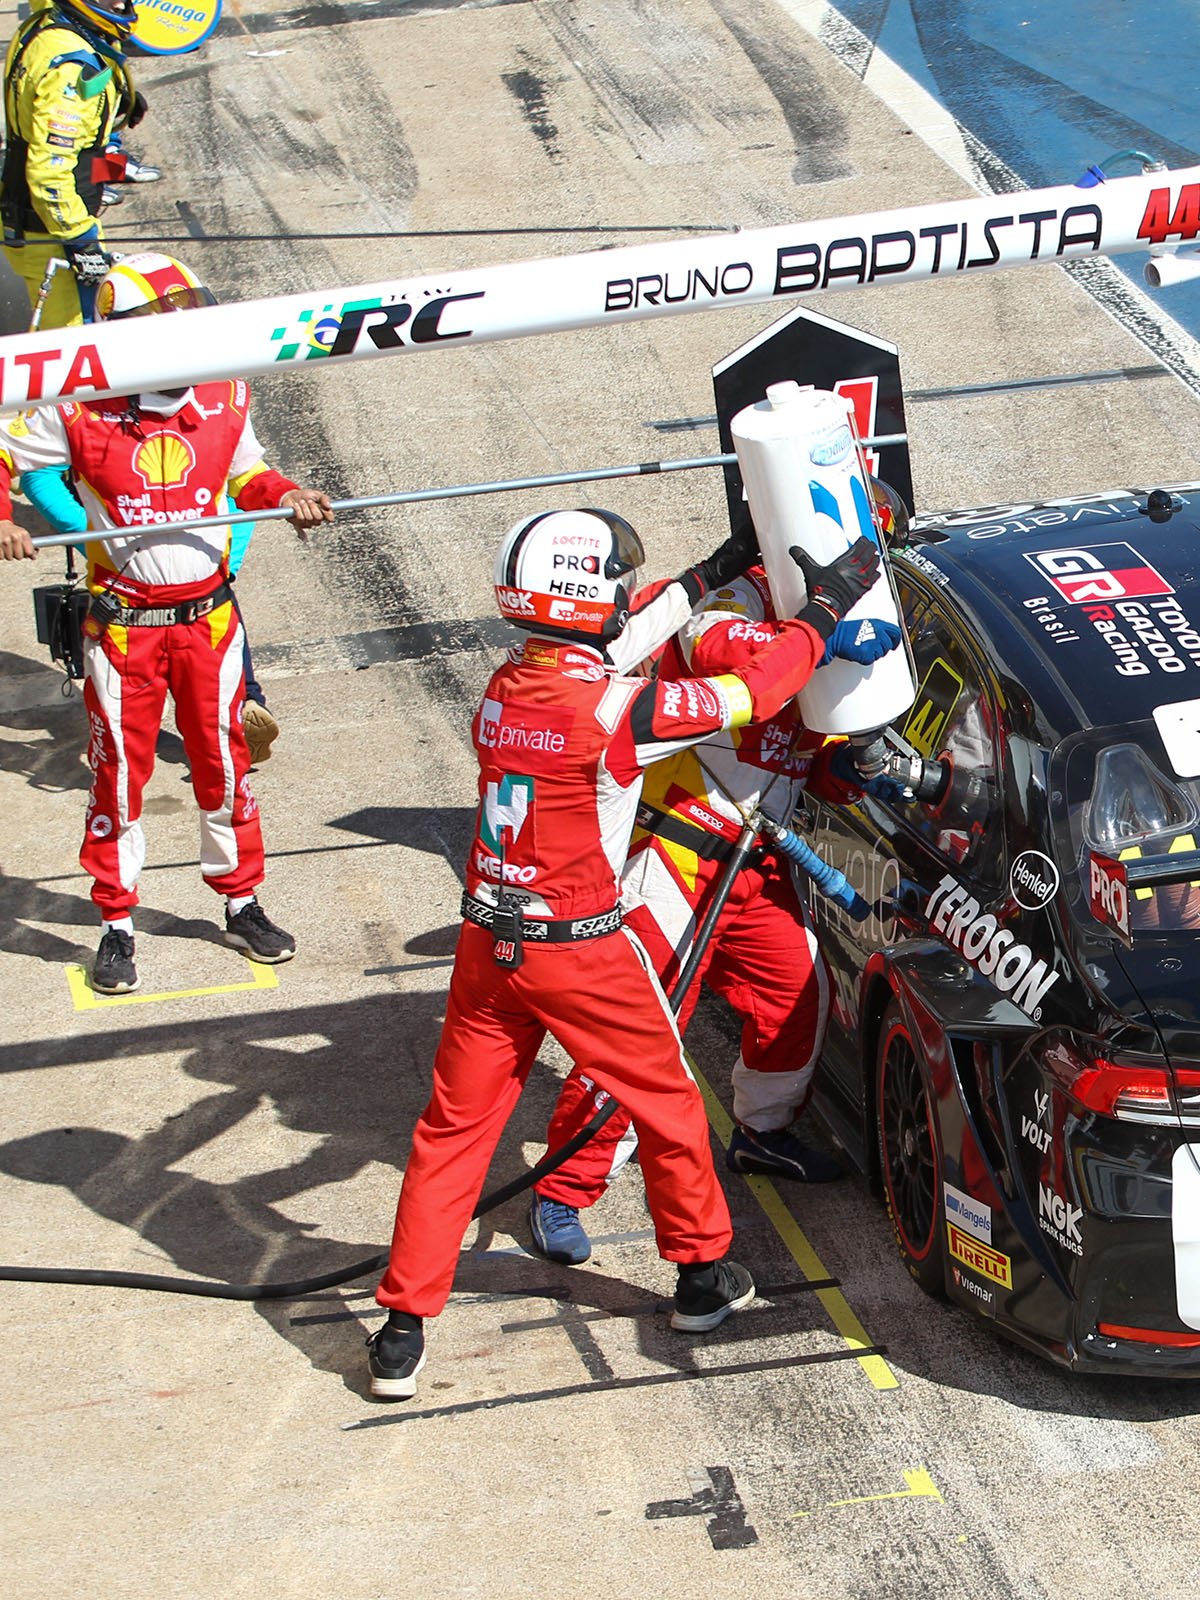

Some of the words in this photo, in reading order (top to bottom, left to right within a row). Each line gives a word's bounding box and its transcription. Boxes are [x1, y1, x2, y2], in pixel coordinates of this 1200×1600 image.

[604, 262, 754, 312] BRUNO
[773, 203, 1103, 296] BAPTISTA
[327, 290, 486, 357] RC
[0, 343, 111, 402] TA
[117, 493, 151, 508] Shell
[118, 507, 205, 526] V-Power
[552, 536, 600, 549] LOCTITE
[553, 553, 600, 575] PRO
[1037, 550, 1126, 601] GR
[497, 588, 535, 610] NGK
[549, 579, 599, 599] HERO
[1023, 596, 1080, 644] Brasil
[1115, 601, 1187, 674] GAZOO
[1081, 604, 1151, 676] Racing
[498, 721, 565, 753] private
[763, 724, 793, 746] Shel
[904, 698, 945, 757] 44
[689, 804, 724, 830] sparco
[476, 852, 538, 883] HERO
[1012, 858, 1055, 902] Henkel
[491, 889, 531, 904] sarco
[1090, 862, 1130, 936] PRO
[494, 939, 516, 962] 44
[924, 873, 1060, 1016] TEROSON
[1021, 1115, 1053, 1154] VOLT
[1039, 1181, 1085, 1244] NGK
[950, 1226, 1008, 1282] PIRELLI
[1038, 1219, 1059, 1241] SPARK
[1058, 1231, 1084, 1257] PLUGS
[961, 1274, 993, 1304] viemar
